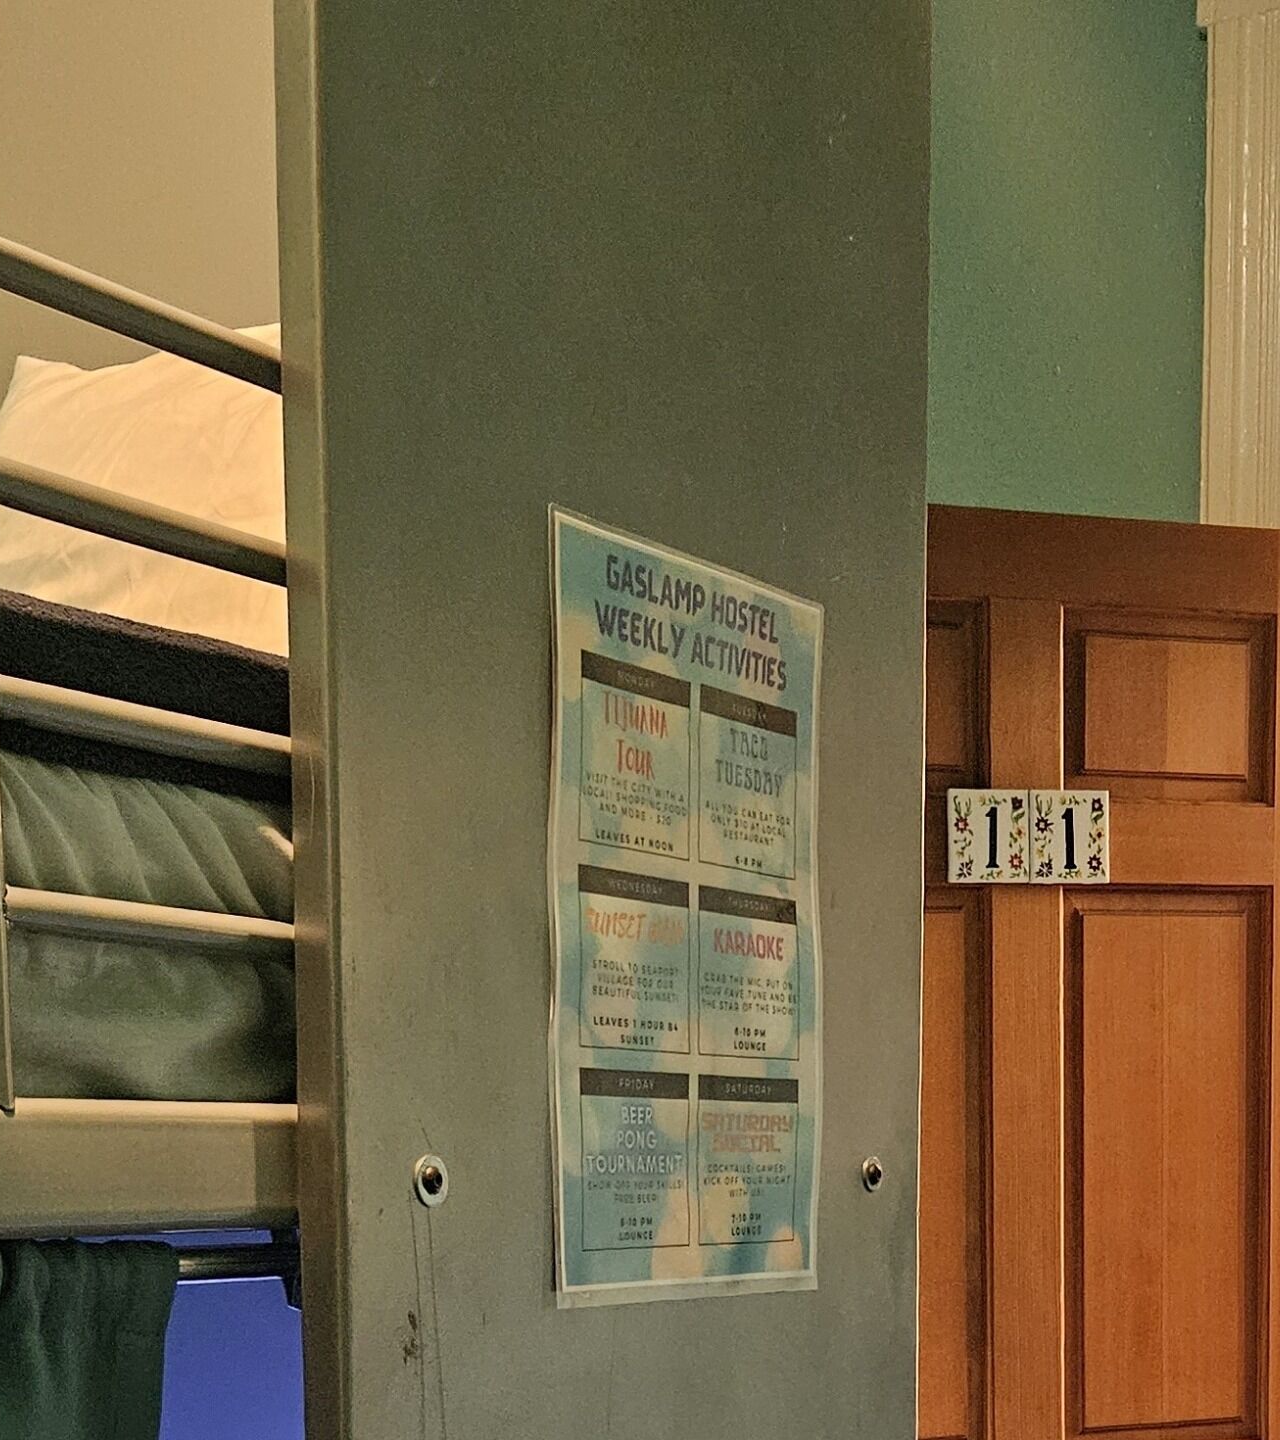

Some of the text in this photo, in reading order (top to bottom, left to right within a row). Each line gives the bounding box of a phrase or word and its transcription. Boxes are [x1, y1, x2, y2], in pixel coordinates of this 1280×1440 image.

[606, 554, 779, 643] GASLAMP HOSTEL
[594, 599, 787, 691] WEEKLY ACTIVITIES
[730, 727, 768, 761] TACO
[616, 738, 656, 780] TOUR
[715, 758, 783, 798] TUESDAY
[599, 802, 618, 814] AND
[595, 829, 673, 852] LEAVES AT NOON
[723, 829, 774, 846] RESTAURANT
[751, 858, 762, 868] PM
[714, 928, 784, 962] KARAOKE
[592, 959, 625, 973] STROLL
[628, 962, 639, 974] TO
[729, 975, 744, 986] THE
[592, 985, 641, 1001] BEAUTIFUL
[747, 989, 767, 1001] TUNE
[770, 993, 785, 1003] AND
[593, 1016, 629, 1029] LEAVES
[640, 1020, 665, 1031] HOUR
[620, 1033, 654, 1046] SUNSET
[753, 1029, 766, 1038] PM
[733, 1039, 767, 1052] LOUNGE
[617, 1077, 654, 1090] FRIDAY
[724, 1082, 771, 1096] SATURDAY
[621, 1105, 653, 1125] BEER
[616, 1129, 658, 1150] PONG
[585, 1153, 683, 1174] TOURNAMENT
[724, 1176, 738, 1186] OFF
[640, 1216, 653, 1227] PM
[749, 1212, 762, 1221] PM
[619, 1230, 654, 1241] LOUNGE
[731, 1225, 762, 1237] LOUNGE
